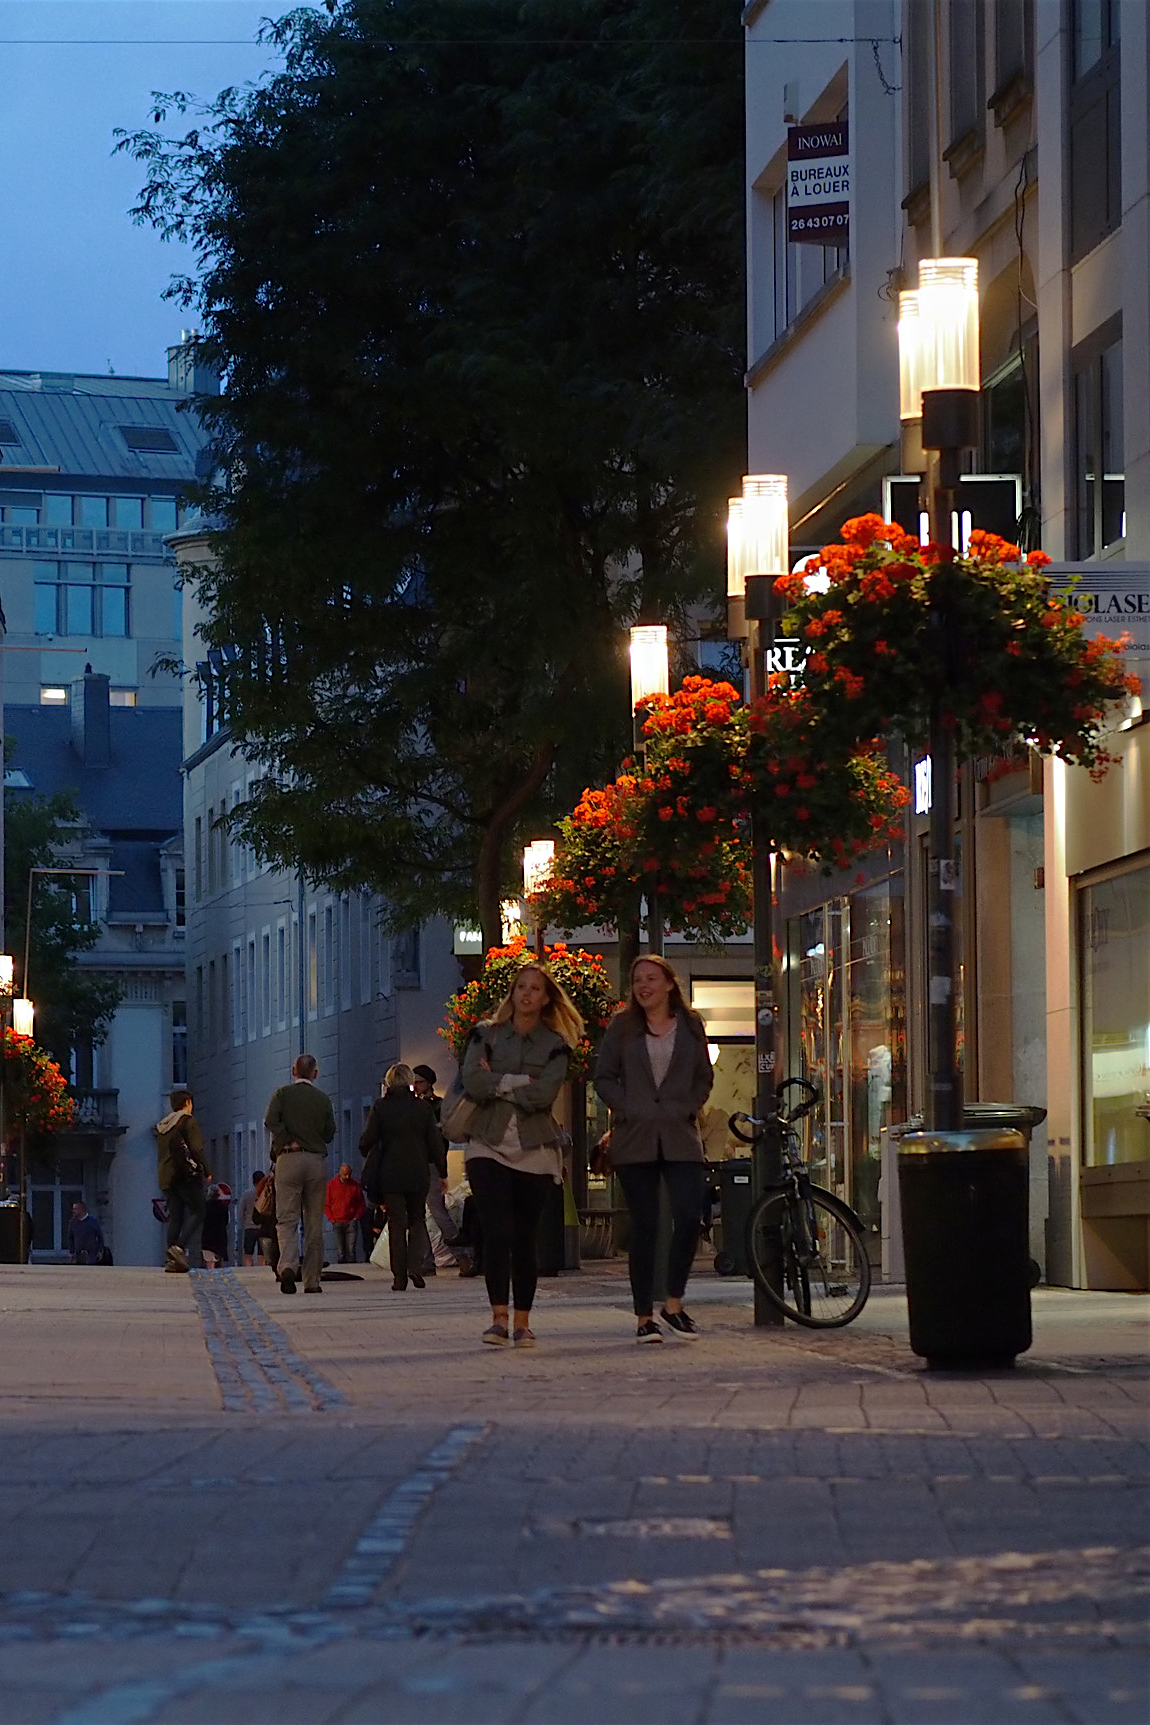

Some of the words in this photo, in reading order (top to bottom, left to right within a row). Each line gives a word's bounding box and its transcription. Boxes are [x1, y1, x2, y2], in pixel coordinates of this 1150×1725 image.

[798, 134, 842, 149] INOWAI
[791, 165, 849, 182] BUREAUX
[790, 182, 800, 198] À
[805, 181, 849, 196] LOUER
[791, 218, 805, 230] 26
[806, 217, 820, 229] 43
[821, 215, 834, 228] 07
[836, 213, 850, 226] 07
